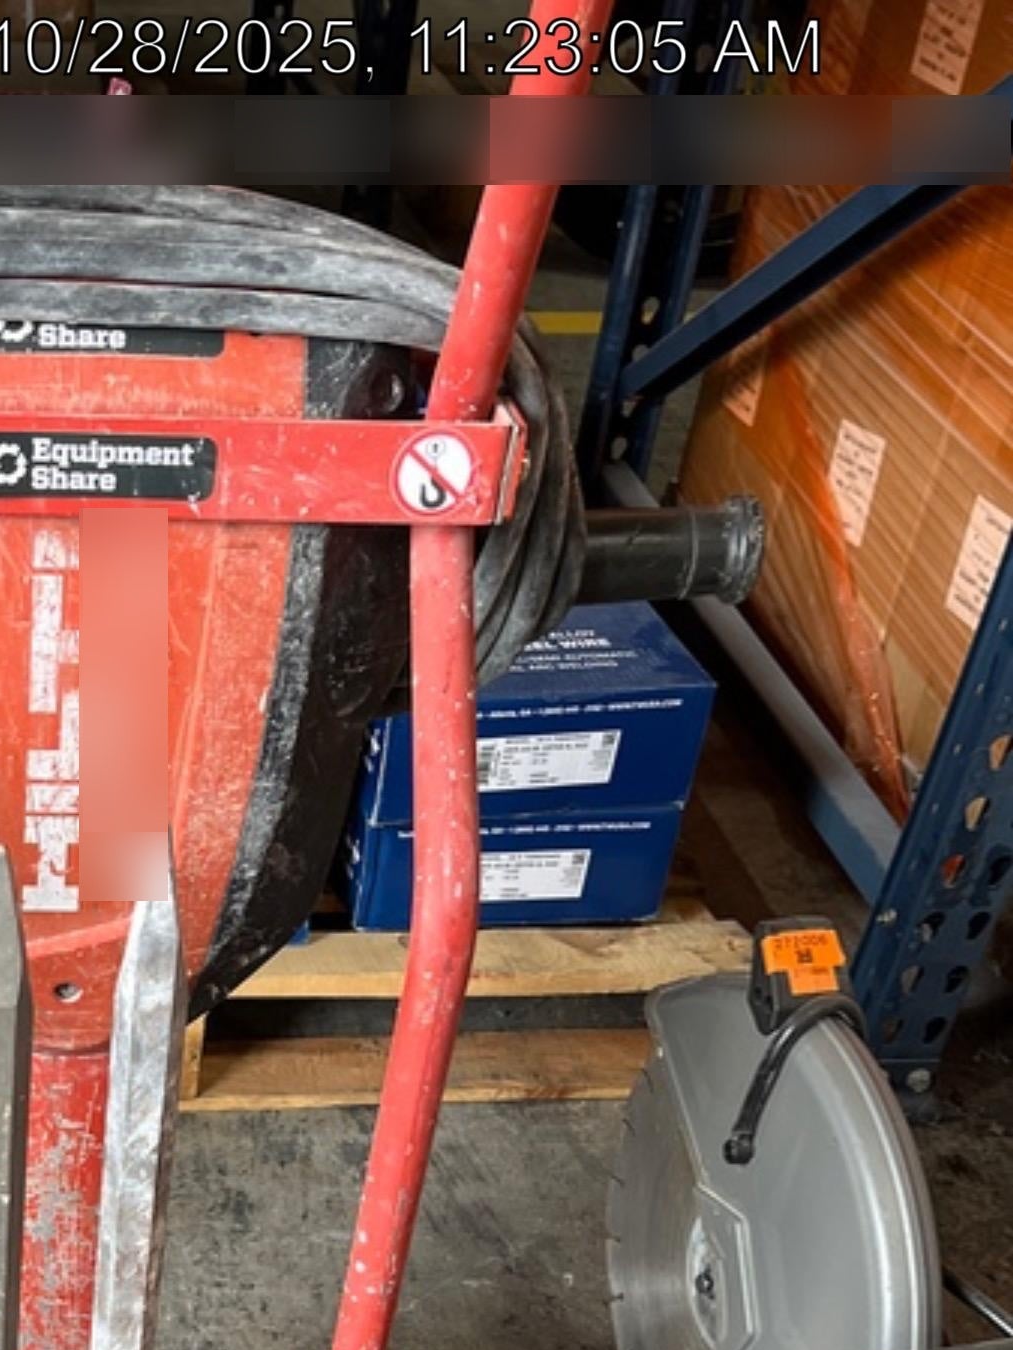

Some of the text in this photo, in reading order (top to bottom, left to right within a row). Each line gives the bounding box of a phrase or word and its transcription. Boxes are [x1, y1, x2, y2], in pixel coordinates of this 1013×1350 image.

[37, 323, 127, 349] Share
[30, 436, 196, 469] Equipment
[30, 465, 118, 491] Share
